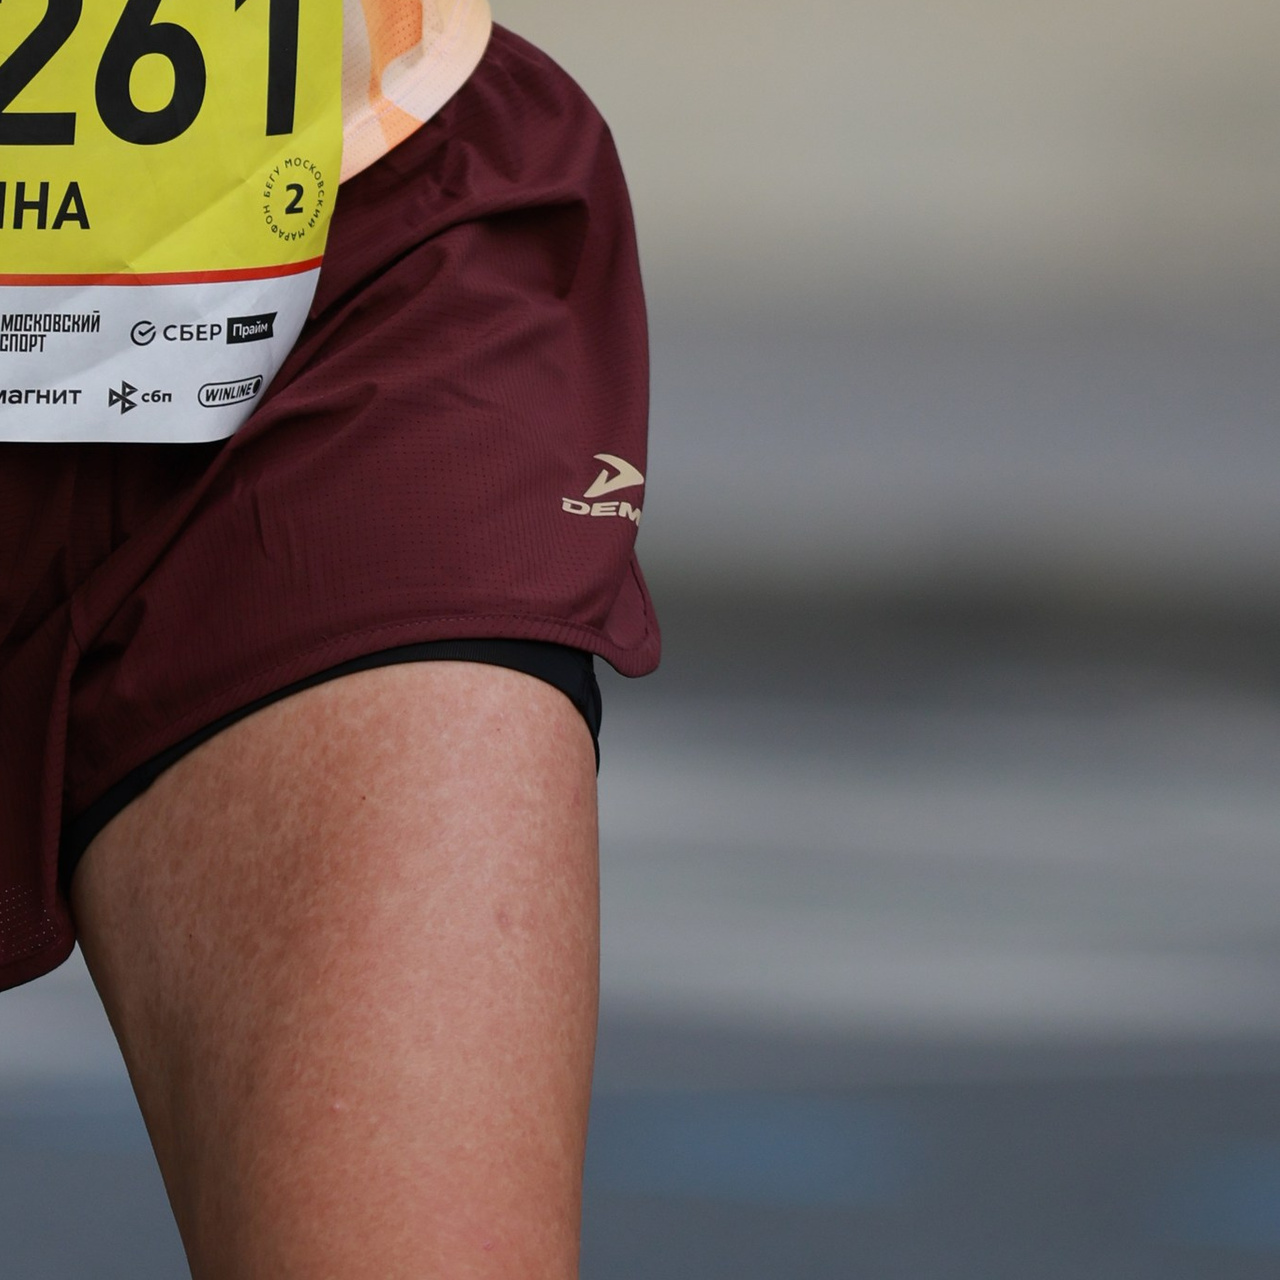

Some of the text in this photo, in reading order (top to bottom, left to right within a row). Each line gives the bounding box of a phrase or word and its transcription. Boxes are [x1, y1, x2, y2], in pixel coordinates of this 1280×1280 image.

[263, 157, 326, 242] БЕГУ МОСКОВСКИЙ МАРАФОН
[285, 183, 304, 215] 2
[1, 310, 100, 333] МОСКОВСКИЙ
[163, 320, 269, 341] СБЕР Прайм
[0, 333, 47, 352] СПОРТ
[205, 382, 254, 403] WINLINE
